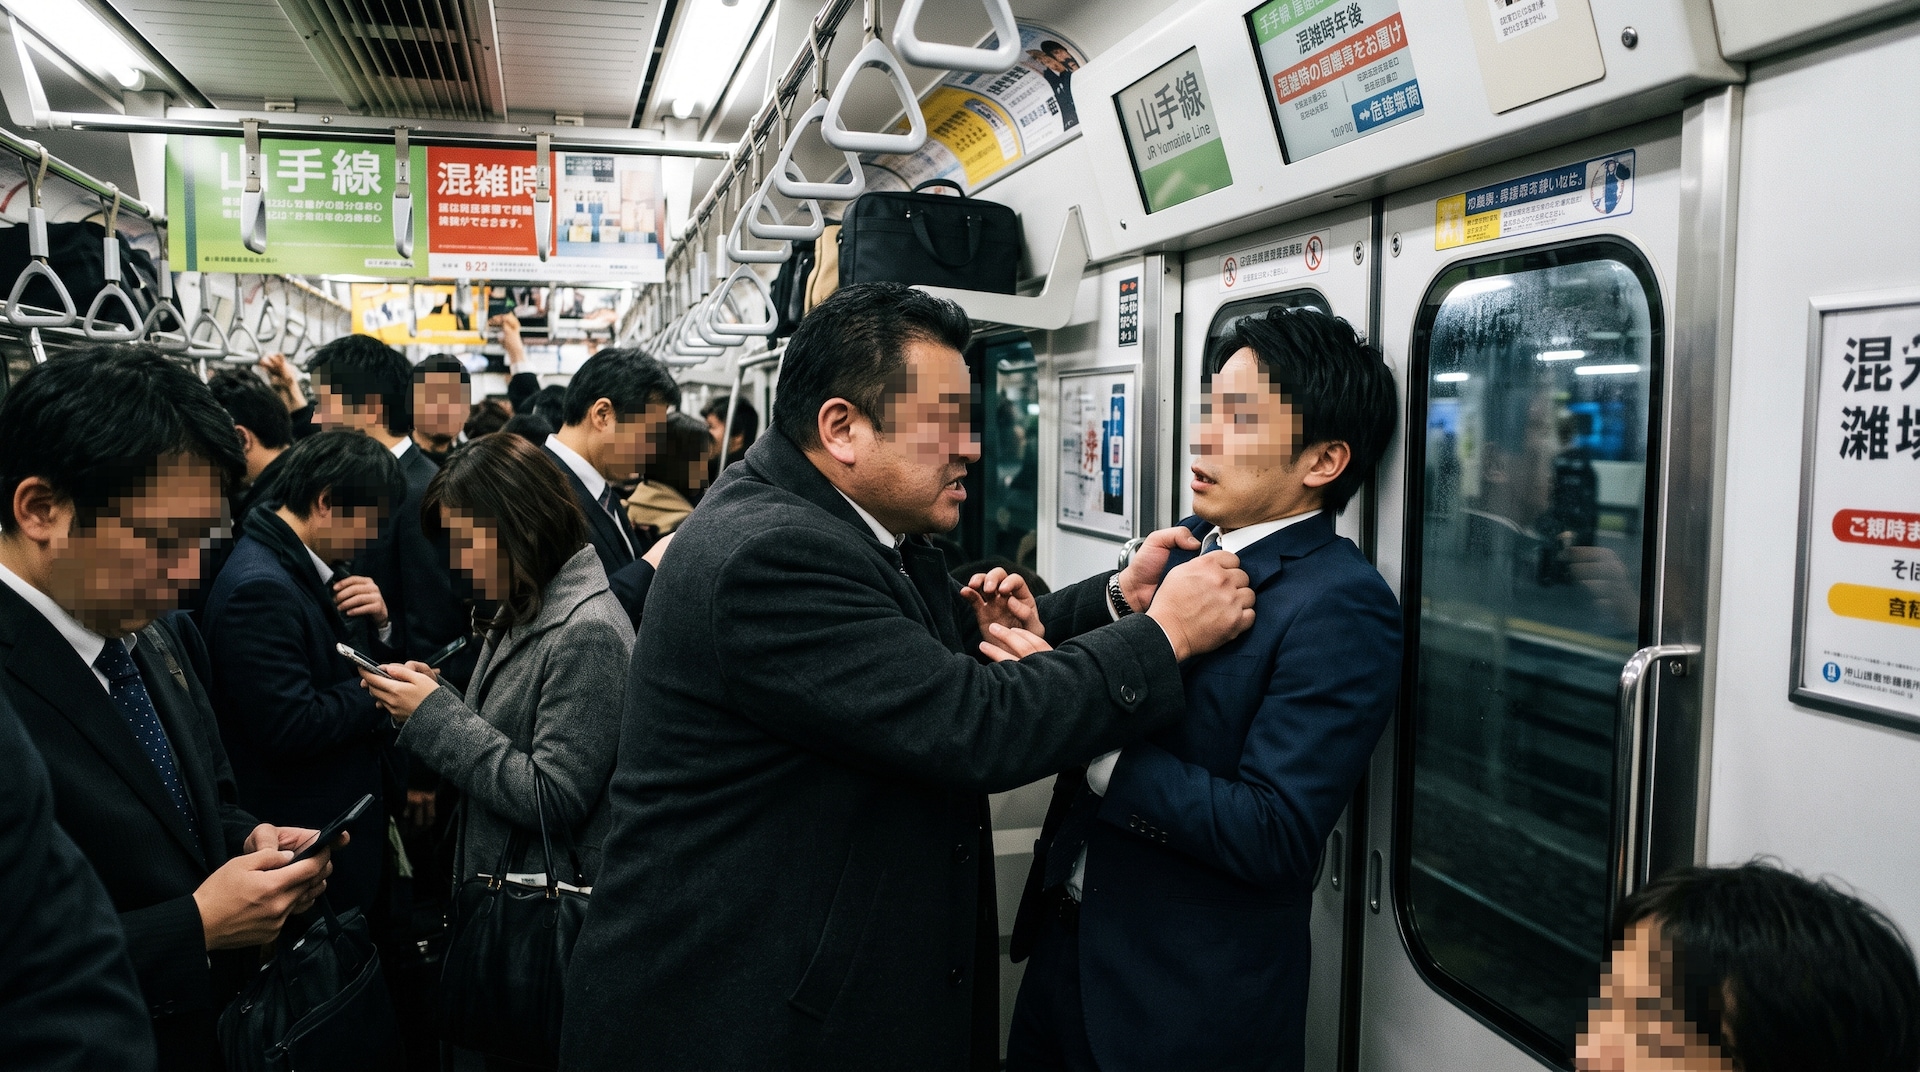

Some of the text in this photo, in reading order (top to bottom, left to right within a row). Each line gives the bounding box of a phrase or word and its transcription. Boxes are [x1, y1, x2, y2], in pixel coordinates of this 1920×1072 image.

[1136, 70, 1206, 142] 山手線
[1147, 145, 1157, 160] JR
[1192, 124, 1211, 140] Line
[220, 144, 383, 196] 山手線
[437, 161, 551, 200] 混雑時
